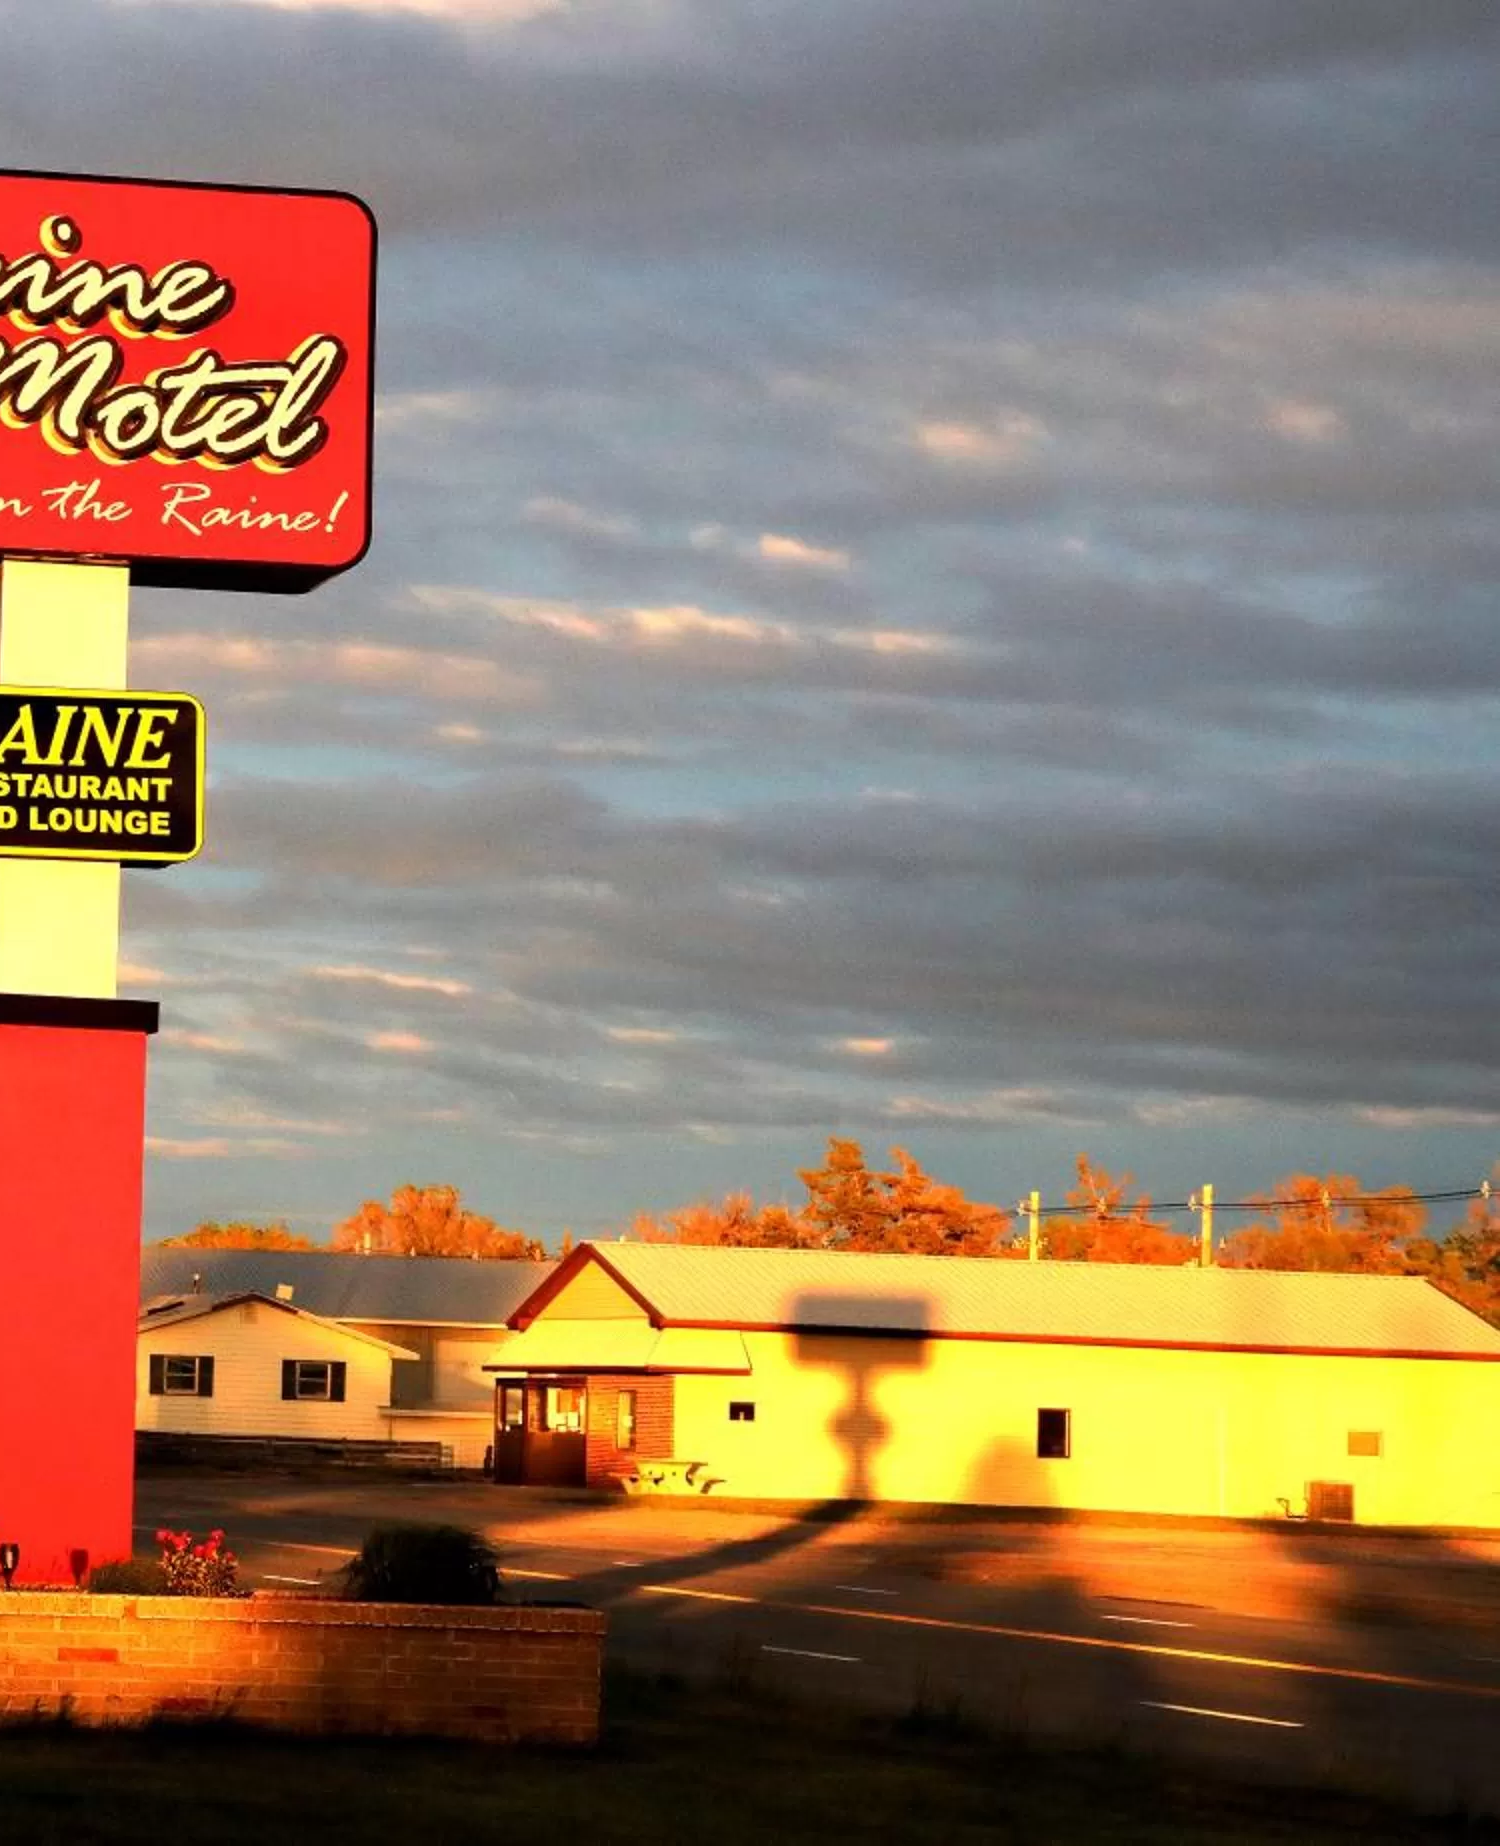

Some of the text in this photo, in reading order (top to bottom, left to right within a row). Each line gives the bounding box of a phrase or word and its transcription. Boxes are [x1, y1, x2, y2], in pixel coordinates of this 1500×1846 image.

[40, 480, 133, 523] the
[160, 482, 350, 537] Raine!
[29, 806, 171, 836] LOUNGE
